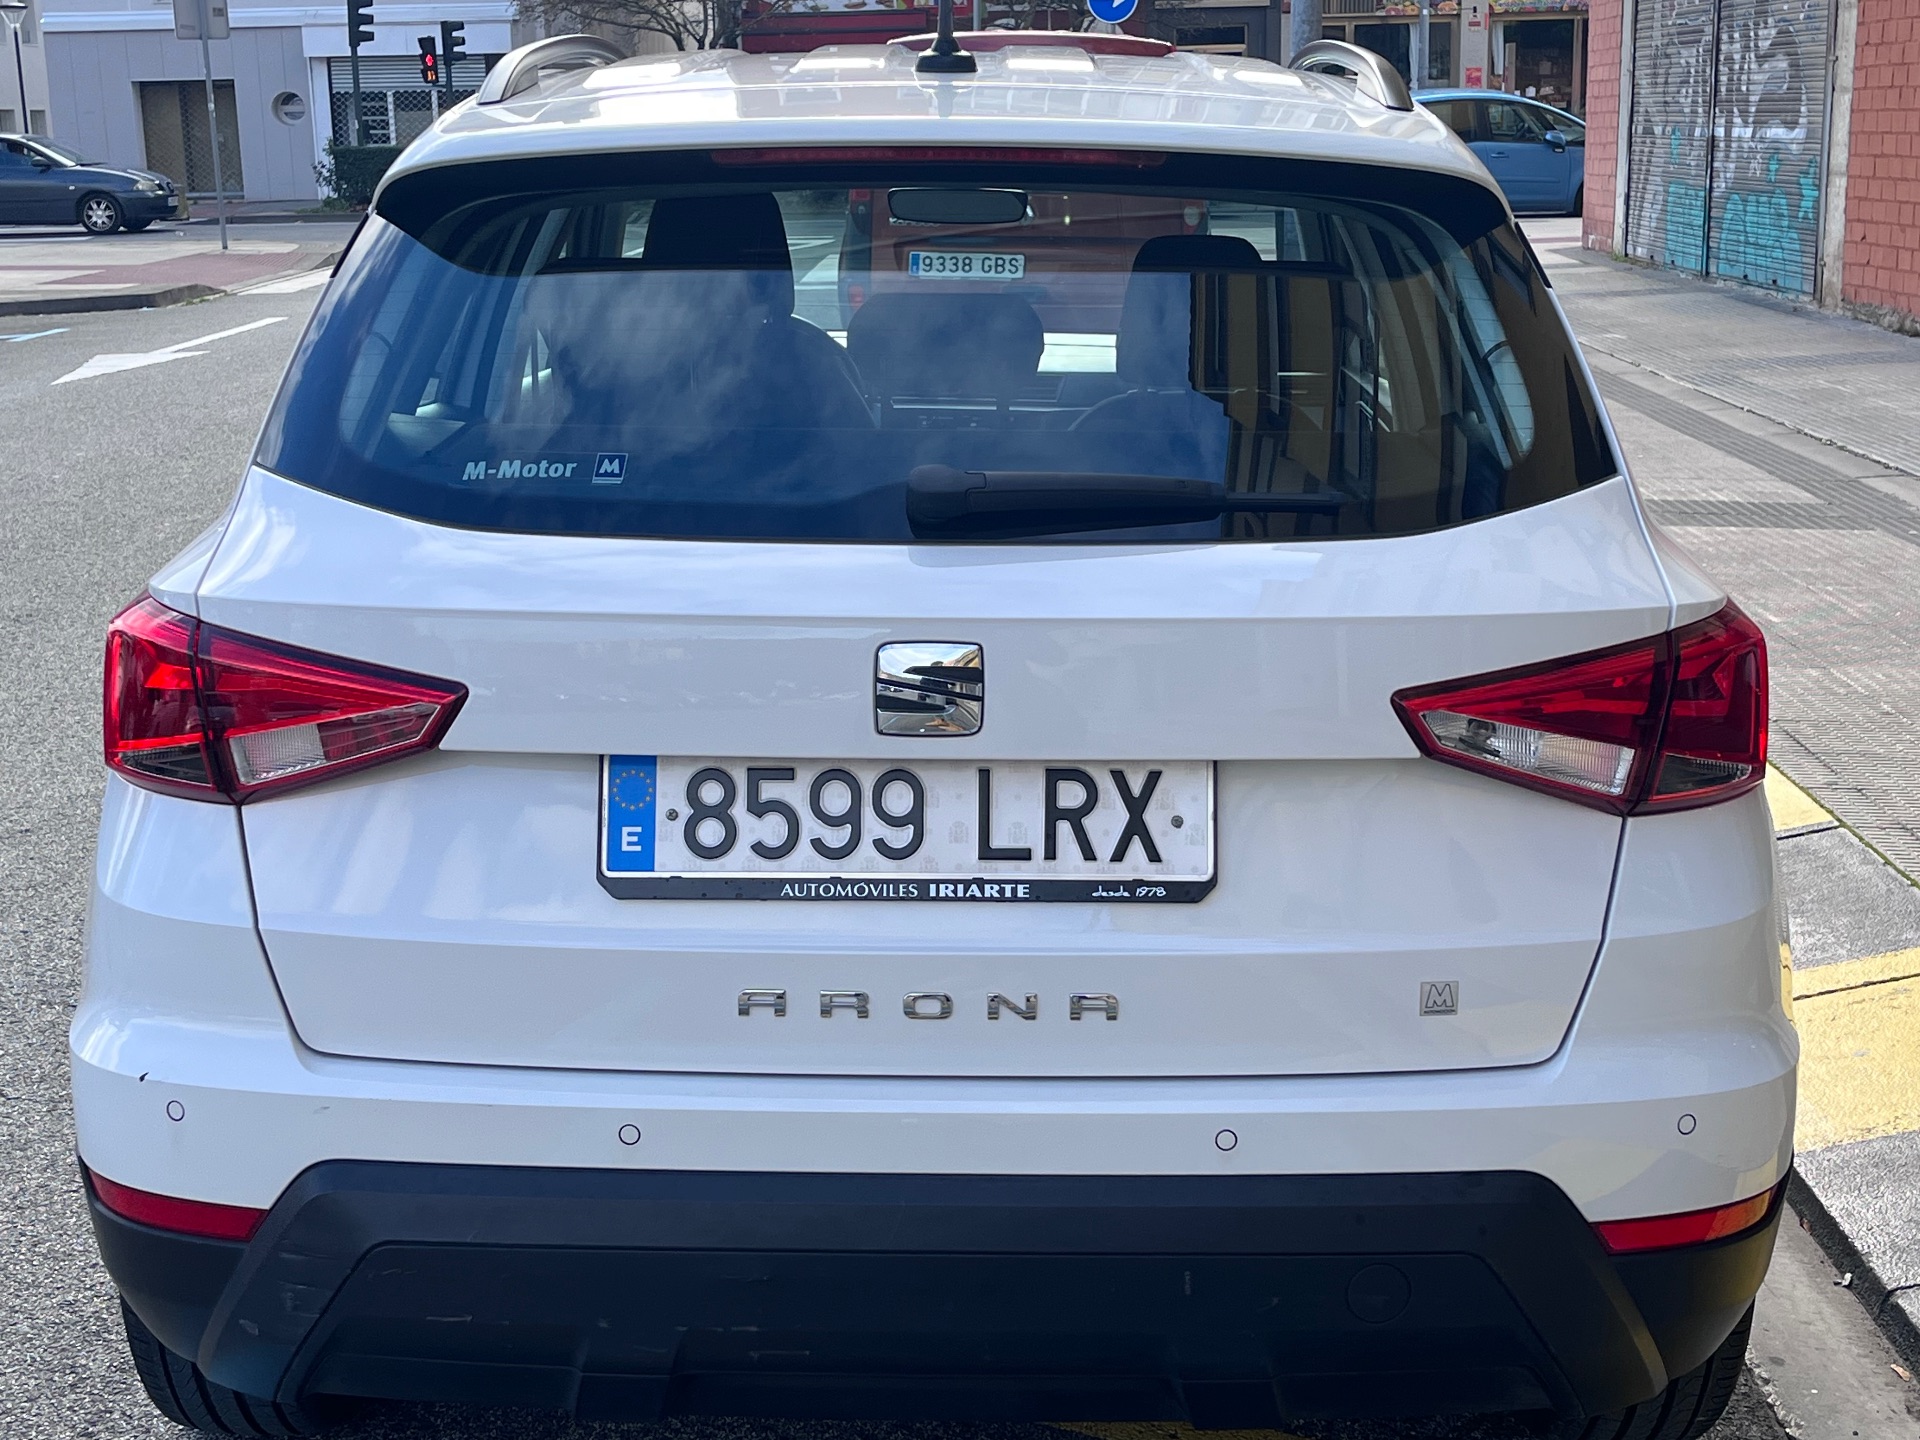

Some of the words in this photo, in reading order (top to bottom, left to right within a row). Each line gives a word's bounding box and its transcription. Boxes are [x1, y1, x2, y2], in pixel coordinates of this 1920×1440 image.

[922, 256, 973, 273] 9338
[981, 256, 1019, 274] GBS
[462, 460, 578, 480] M-Motor
[599, 458, 620, 473] M
[683, 767, 924, 860] 8599
[977, 768, 1163, 862] LRX
[621, 826, 642, 851] E
[780, 881, 918, 897] AUTOMÓVILES
[929, 884, 1030, 898] IRIARTE
[1091, 885, 1131, 897] desde
[1135, 886, 1167, 897] 1978
[738, 988, 1120, 1021] ARONA
[1425, 983, 1455, 1009] M
